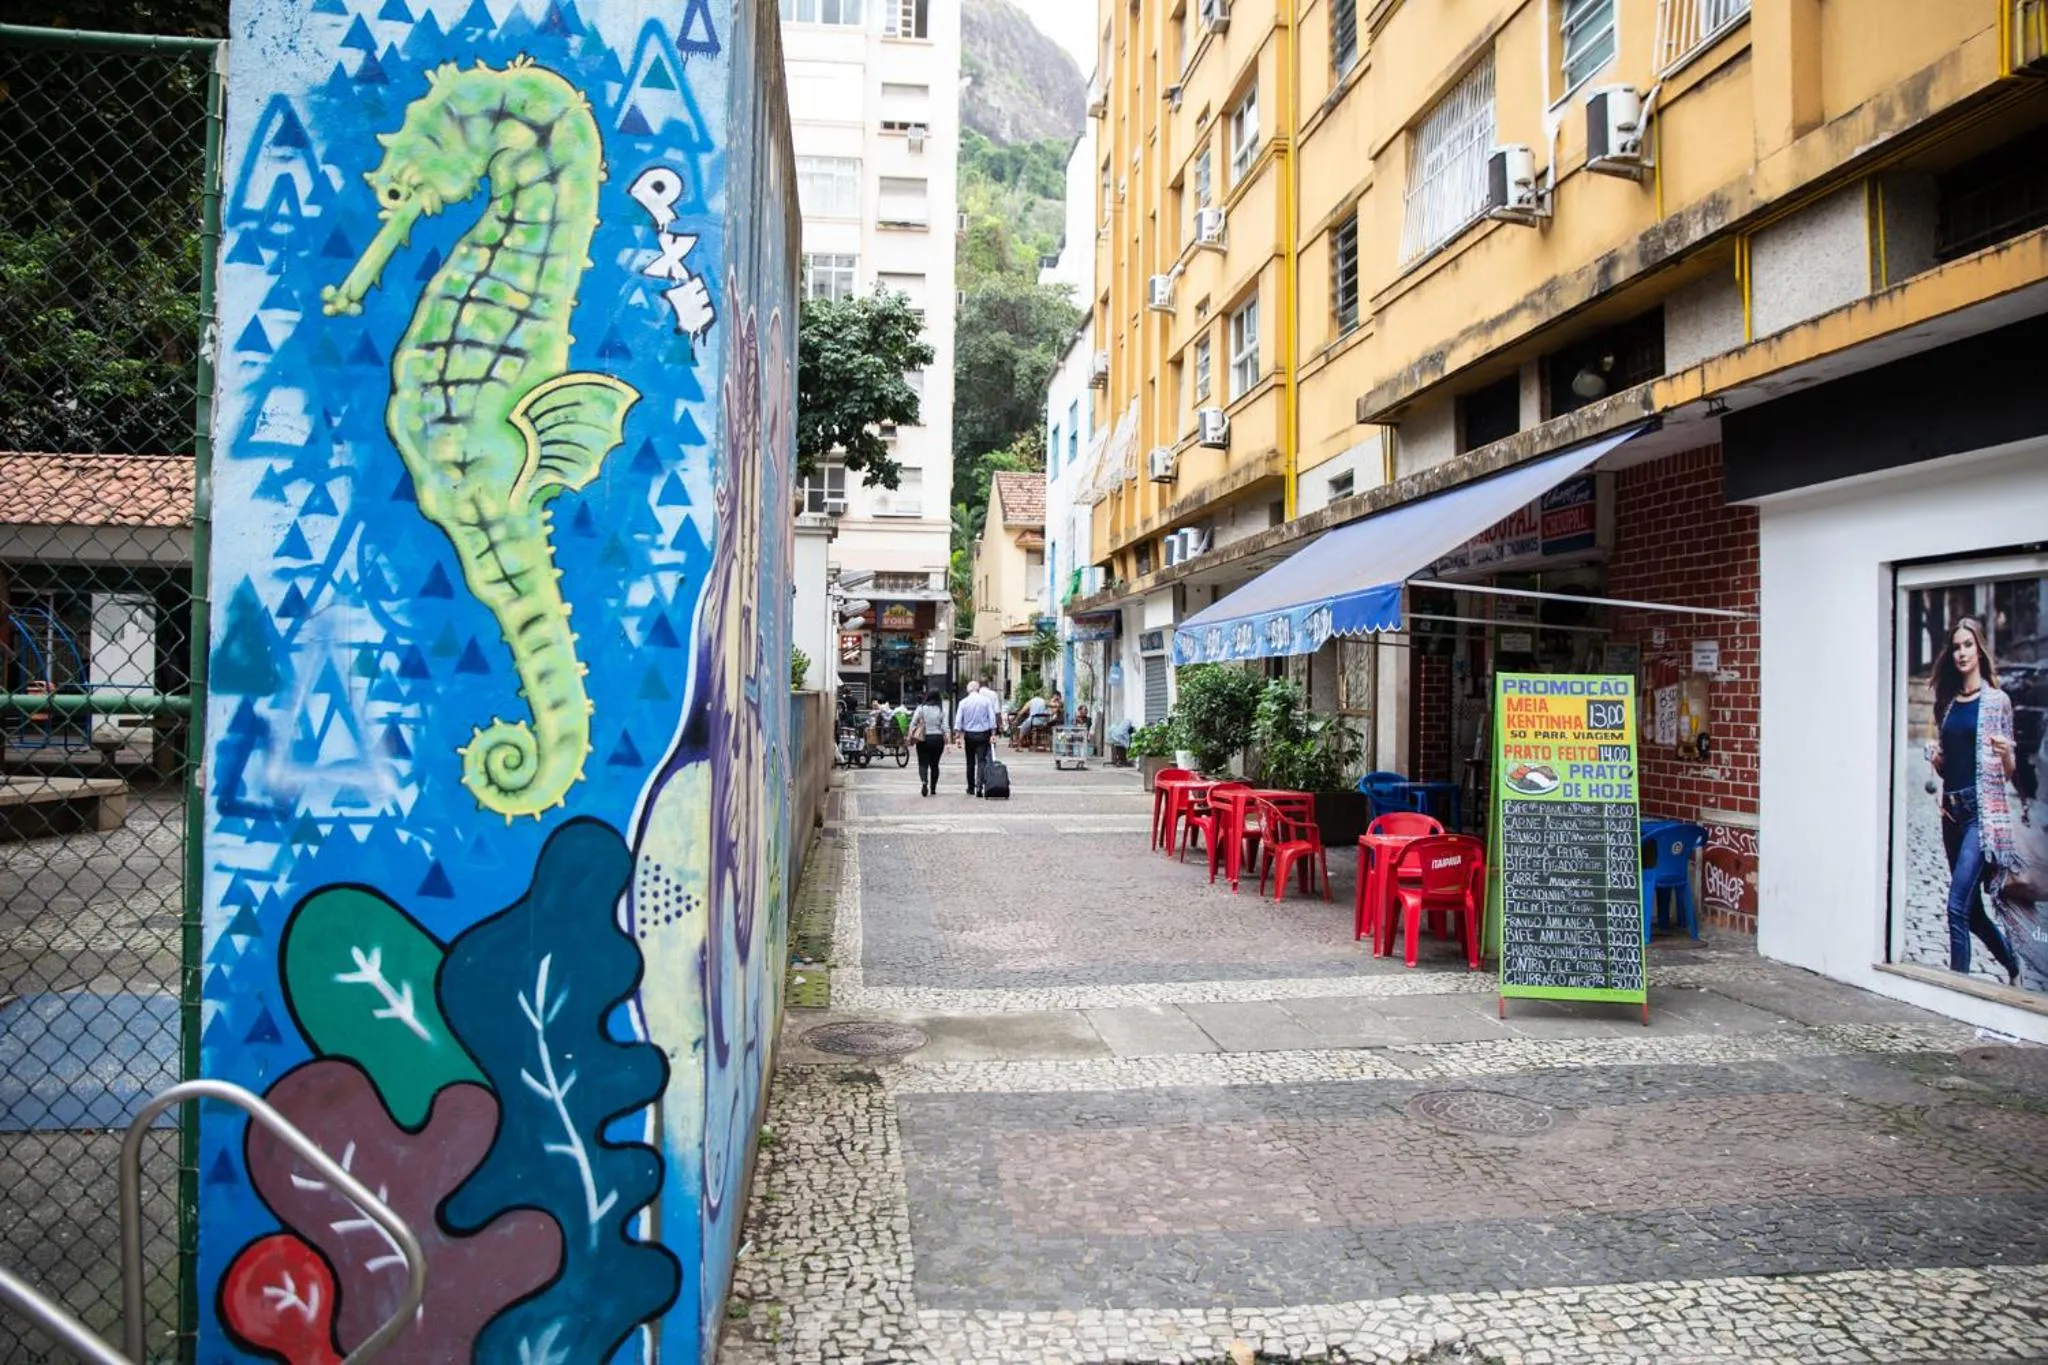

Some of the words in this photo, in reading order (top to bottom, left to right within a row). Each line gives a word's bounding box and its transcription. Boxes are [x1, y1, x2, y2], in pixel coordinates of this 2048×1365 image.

[1506, 698, 1549, 713] MEIA
[1506, 715, 1583, 730] KENTINHA
[1534, 731, 1567, 740] PARA
[1573, 731, 1624, 741] VIAGEM
[1504, 744, 1552, 760] PRATO
[1558, 746, 1599, 761] FEITO
[1569, 764, 1632, 780] PRATO
[1563, 783, 1582, 798] DE
[1588, 784, 1632, 799] HOJE
[1504, 816, 1540, 830] CARNE
[1504, 829, 1541, 843] FRANGO
[1505, 857, 1531, 871] BIFE
[1505, 928, 1535, 943] BIFE
[1504, 957, 1545, 972] CONTRA
[1504, 972, 1567, 986] CHURRASCO
